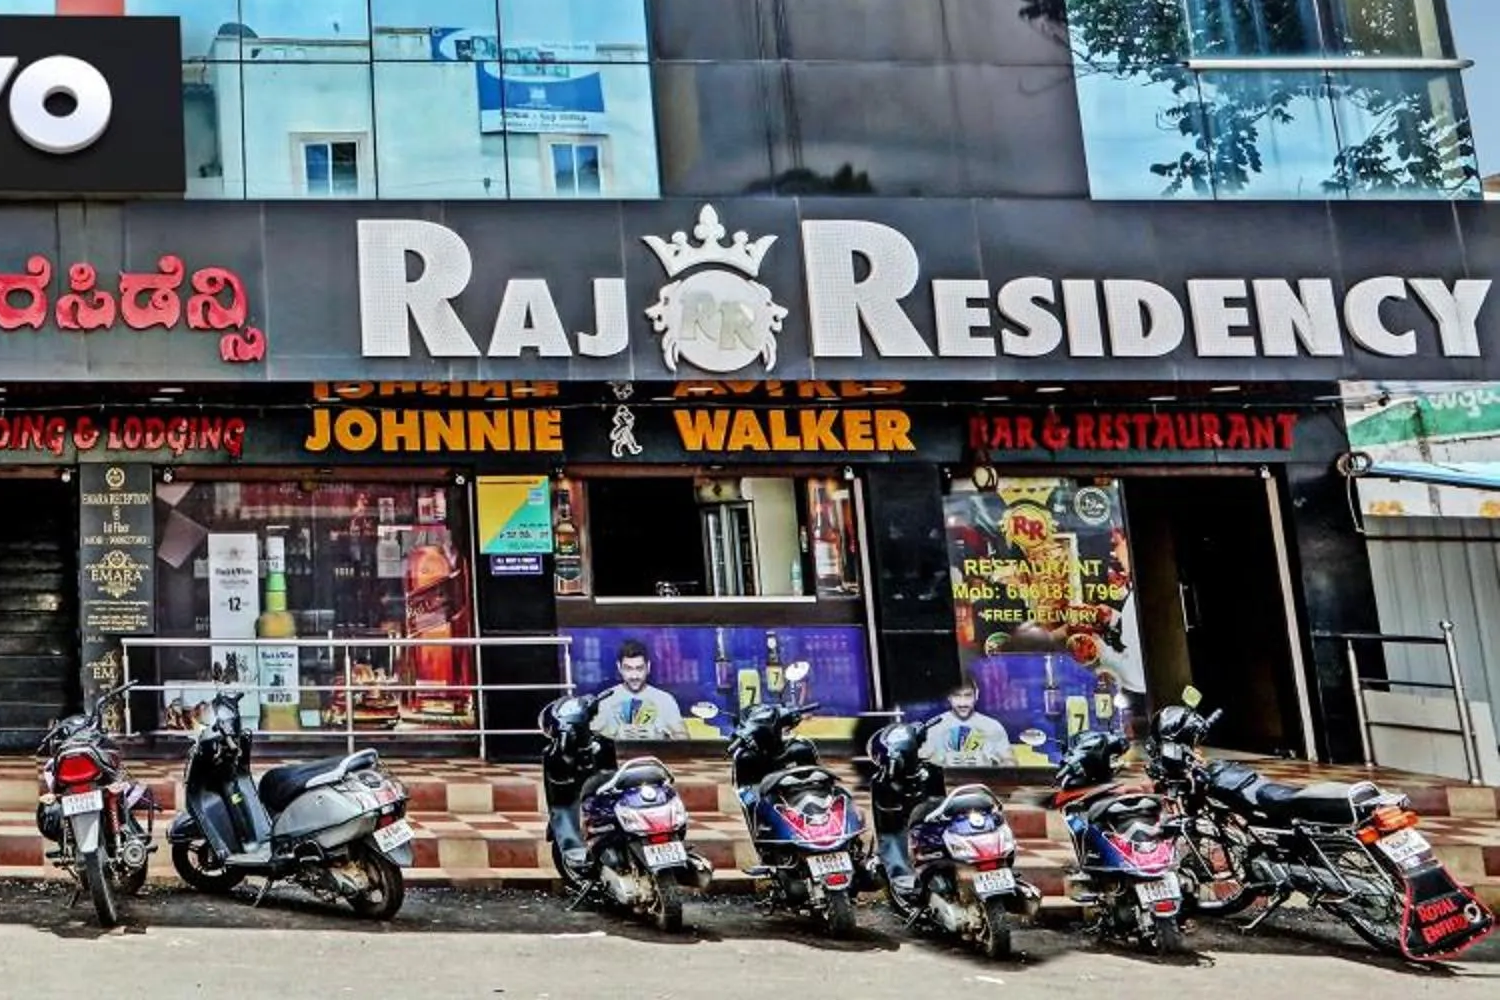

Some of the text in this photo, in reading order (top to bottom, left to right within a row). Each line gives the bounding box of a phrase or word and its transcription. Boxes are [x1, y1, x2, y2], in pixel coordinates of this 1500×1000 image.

[106, 415, 246, 457] LODGING
[304, 409, 919, 452] JOHNNIE WALKER
[1076, 413, 1300, 451] RESTAURANT
[1012, 515, 1047, 541] RR
[91, 569, 143, 582] EMARA
[964, 559, 1103, 577] RESTAURANT
[953, 583, 1001, 599] Mob:
[227, 596, 242, 611] 12
[984, 609, 1100, 623] FREE DELIVERY
